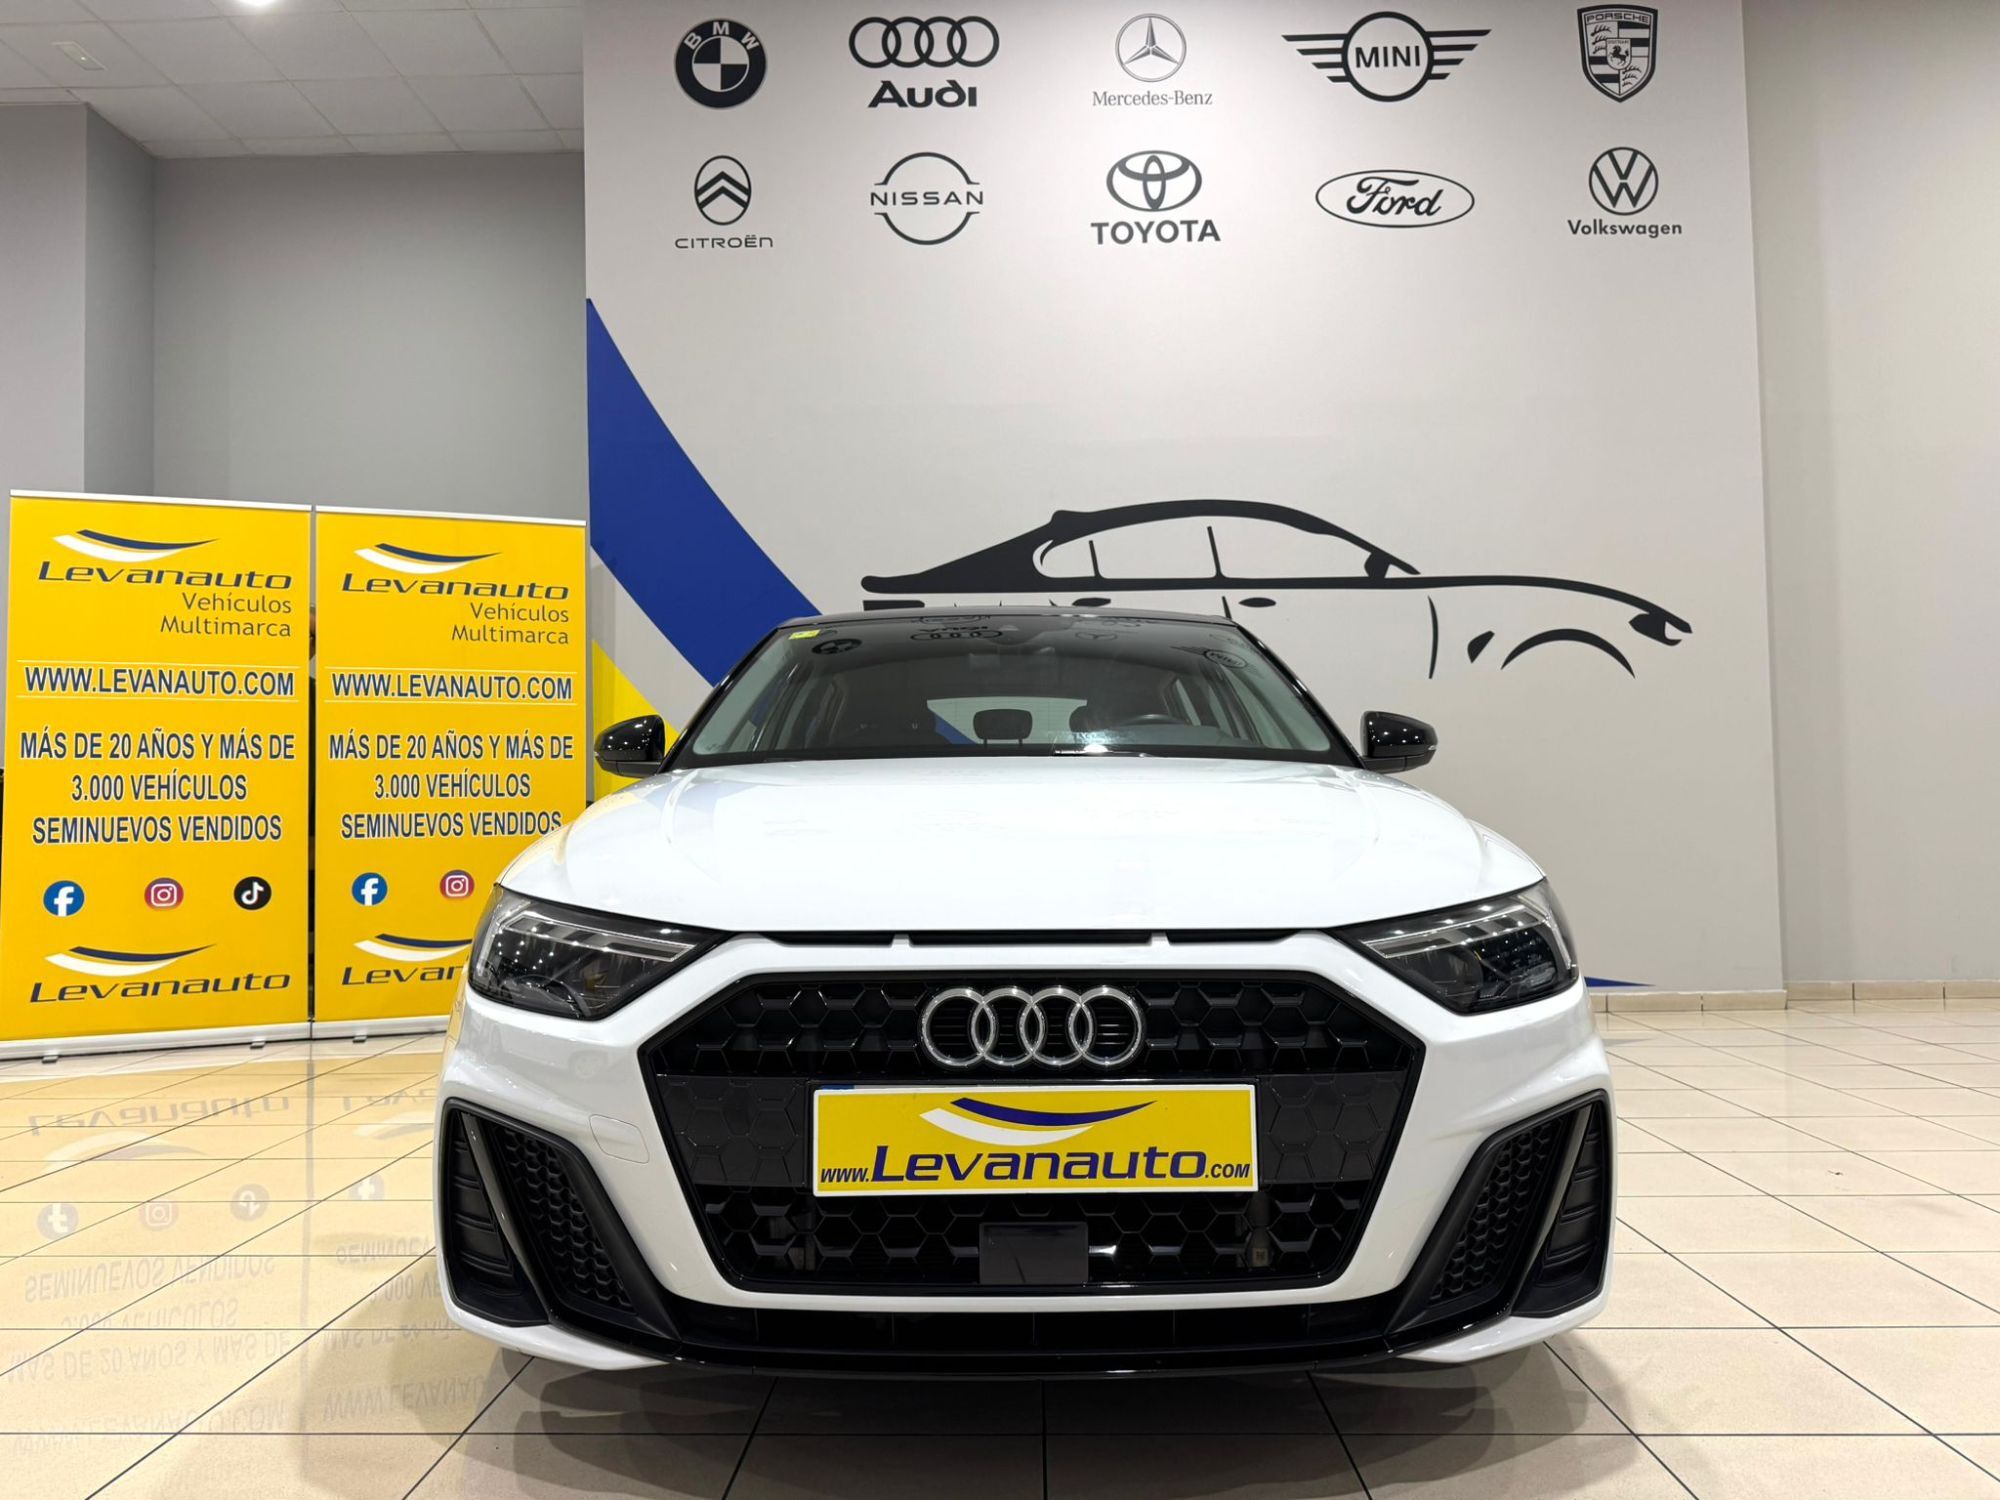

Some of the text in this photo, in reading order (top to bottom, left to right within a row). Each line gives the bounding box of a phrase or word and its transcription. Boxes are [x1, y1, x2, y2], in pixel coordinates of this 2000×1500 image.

[1586, 12, 1650, 23] PORSCHE
[683, 21, 760, 50] BMW
[1355, 45, 1421, 68] MINI
[1092, 90, 1213, 106] Mercedes-Benz
[870, 190, 983, 206] NISSAN
[1346, 177, 1442, 217] Ford
[1090, 219, 1221, 245] TOYOTA
[1567, 218, 1682, 239] Volkswagen
[38, 561, 292, 590] Levanauto
[342, 573, 569, 600] Levanauto
[181, 592, 292, 614] Vehículos
[470, 602, 569, 623] Vehículos
[160, 615, 292, 637] Multimarca
[451, 625, 569, 645] Multimarca
[25, 666, 294, 697] WWW.LEVANAUTO.COM
[332, 673, 572, 700] WWW.LEVANAUTO.COM
[20, 726, 295, 760] MÁS DE 20 AÑOS Y MÁS DE
[329, 728, 573, 760] MÁS DE 20 AÑOS Y MÁS DE
[71, 767, 247, 801] 3.000 VEHÍCULOS
[374, 767, 531, 799] 3.000 VEHÍCULOS
[32, 814, 282, 844] SEMINUEVOS VENDIDOS
[341, 810, 562, 839] SEMINUEVOS VENDIDOS
[30, 973, 291, 1003] Levanauto
